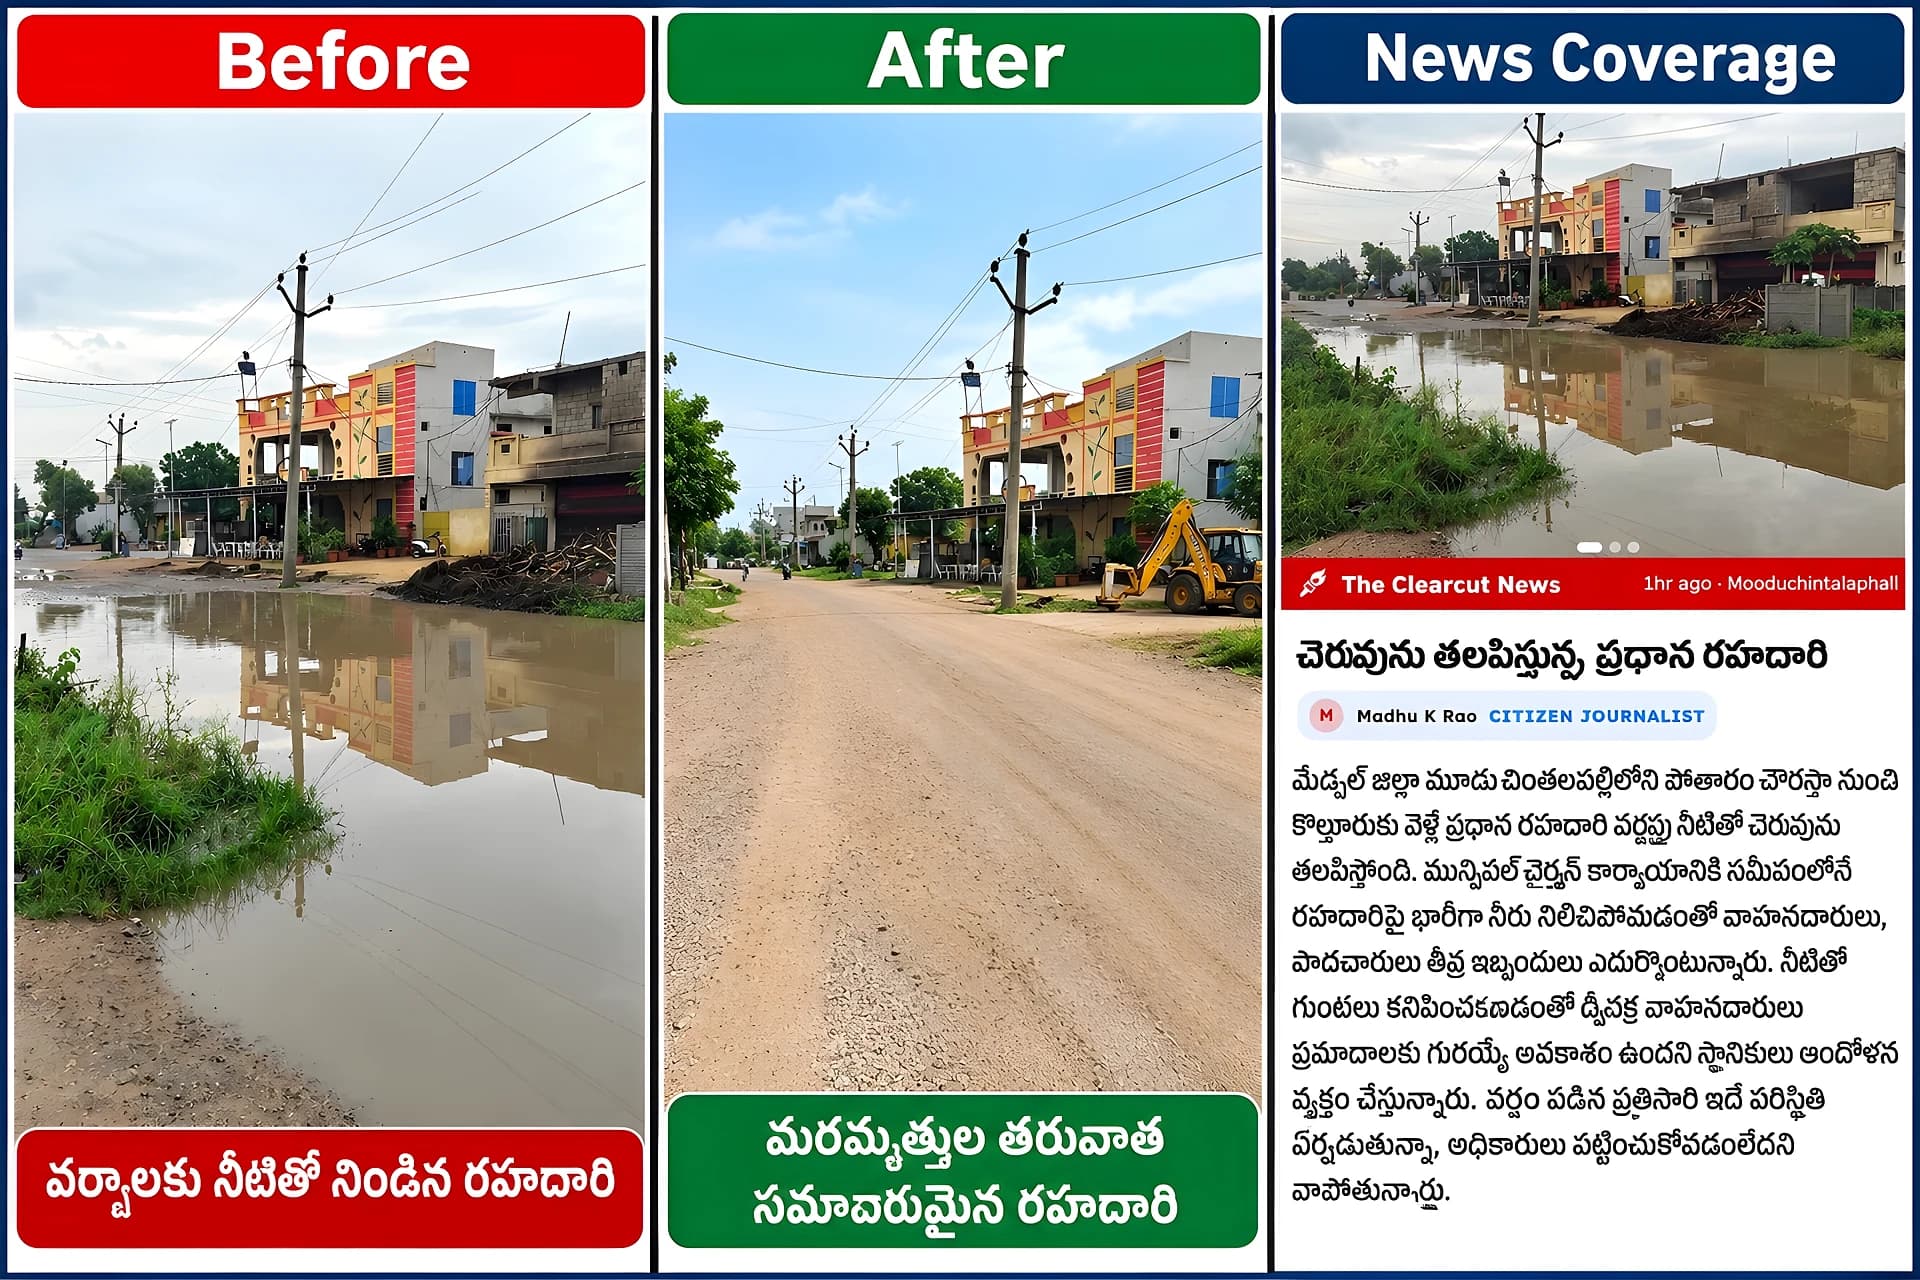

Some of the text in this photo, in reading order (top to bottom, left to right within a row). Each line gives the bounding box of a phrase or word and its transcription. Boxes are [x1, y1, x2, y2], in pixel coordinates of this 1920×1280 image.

[1341, 574, 1561, 594] The Clearcut News
[1643, 574, 1899, 595] 1hr ago Mooduchintalaphall
[1295, 638, 1426, 676] చెరువును
[1595, 638, 1695, 677] ప్రధాన
[1702, 638, 1828, 669] రహదారి
[1319, 707, 1334, 722] M
[1357, 708, 1705, 723] Madhu K Rao CITIZEN JOURNALIST
[1372, 772, 1420, 800] జిల్లా
[1425, 767, 1498, 791] మూడు
[1664, 767, 1755, 791] పోతారం
[1758, 767, 1832, 798] చౌరస్తా
[1445, 812, 1512, 842] ప్రధాన
[1517, 812, 1608, 837] రహదారి
[1676, 808, 1744, 837] నీటితో
[1747, 812, 1841, 842] చెరువును
[1291, 856, 1417, 889] తలపిస్తోంది.
[1726, 854, 1852, 882] సమీపంలోనే
[1292, 903, 1405, 936] రహదారిపై
[1411, 900, 1484, 933] భారీగా
[1488, 900, 1532, 928] నీరు
[1722, 903, 1887, 932] వాహనదారులు,
[1291, 949, 1421, 973] పాదచారులు
[1426, 945, 1466, 979] తీవ్ర
[1780, 945, 1848, 973] నీటితో
[1644, 994, 1804, 1019] వాహనదారులు
[1291, 1040, 1421, 1071] ప్రమాదాలకు
[1427, 1036, 1510, 1074] గురయ్యే
[1515, 1040, 1613, 1065] అవకాశం
[1618, 1040, 1692, 1065] ఉందని
[1799, 1036, 1899, 1065] ఆందోళన
[1356, 1082, 1477, 1120] చేస్తున్నారు.
[1546, 1084, 1606, 1110] పడిన
[1705, 1082, 1743, 1111] ఇదే
[1447, 1131, 1566, 1161] అధికారులు
